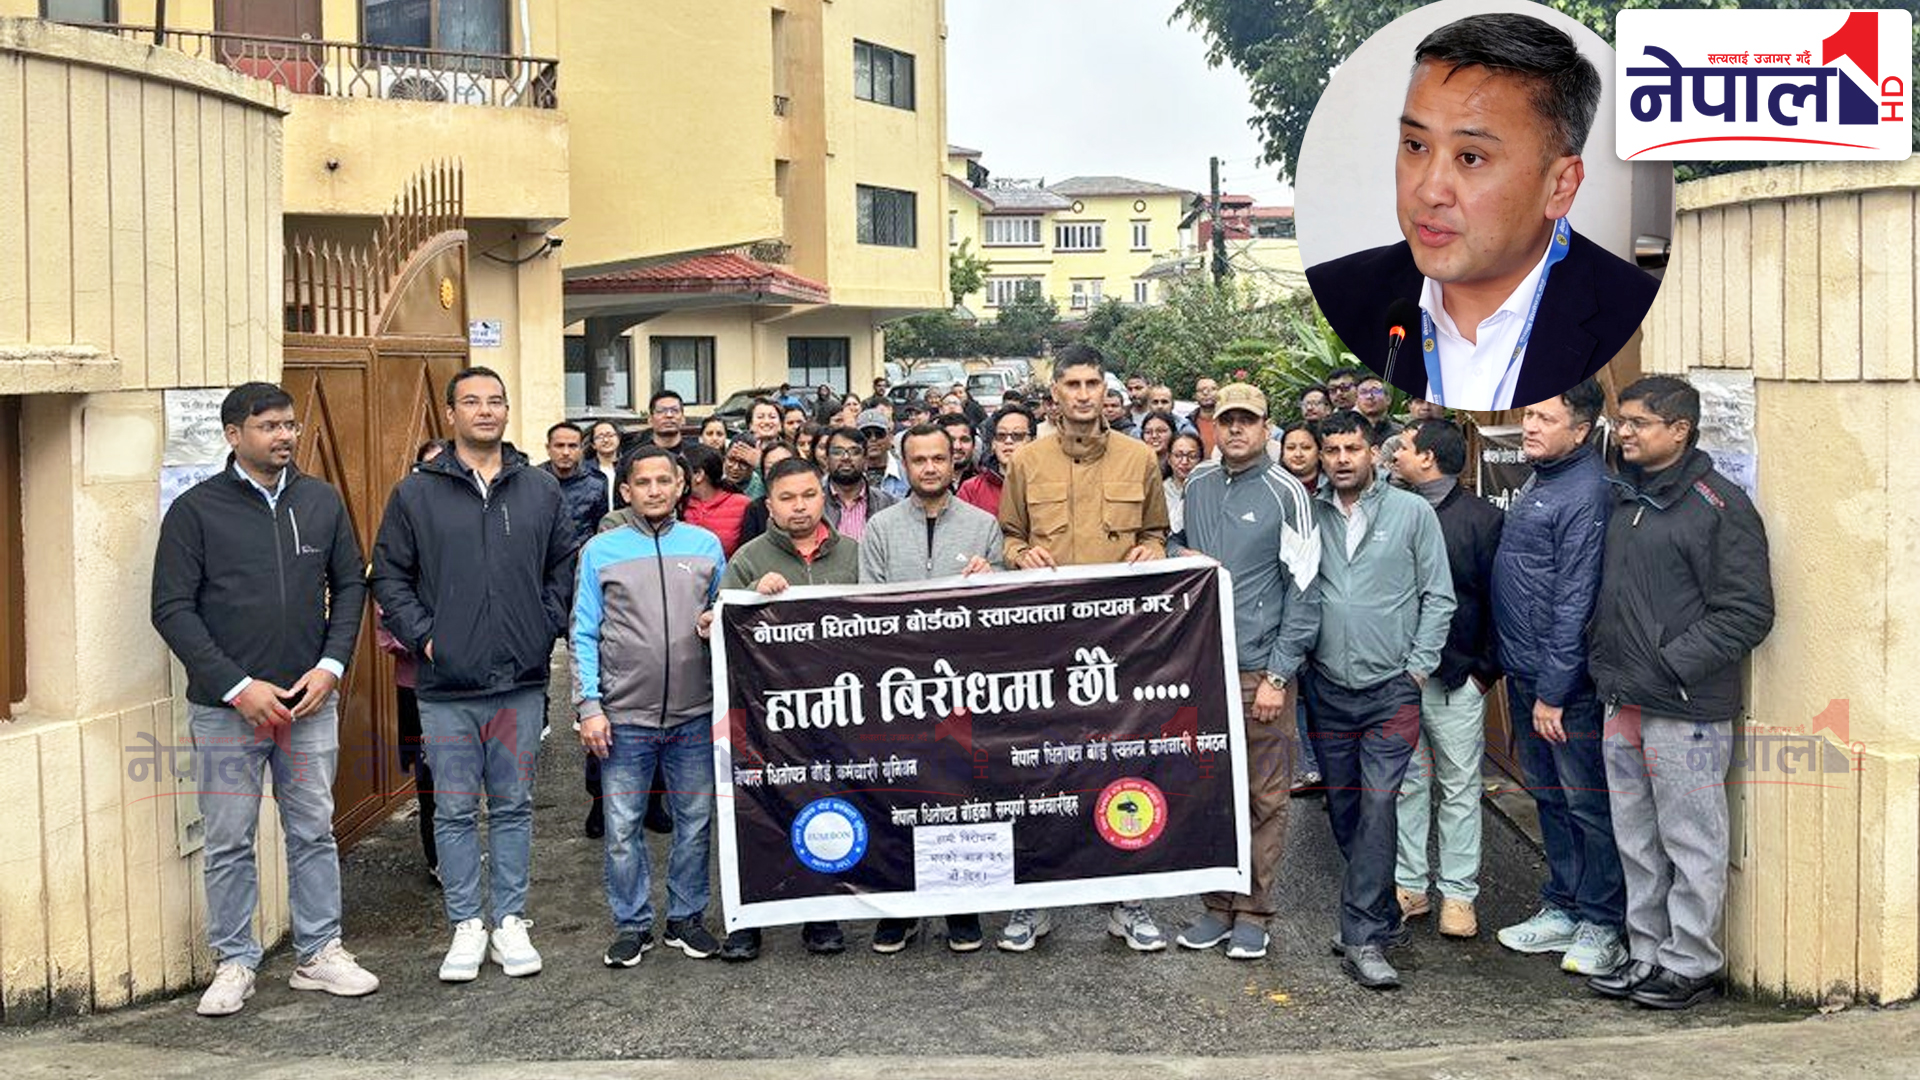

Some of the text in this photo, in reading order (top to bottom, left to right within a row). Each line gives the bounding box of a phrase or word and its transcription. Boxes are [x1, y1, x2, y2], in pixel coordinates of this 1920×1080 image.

[753, 621, 815, 643] नेपाल
[821, 614, 900, 638] धितोपत्र
[906, 606, 971, 631] बोर्डको
[978, 604, 1066, 628] स्वायतत्ता
[1072, 598, 1135, 619] कायम
[1142, 594, 1174, 613] गर
[763, 672, 865, 731] हामी
[877, 658, 1055, 722] बिरोधमा
